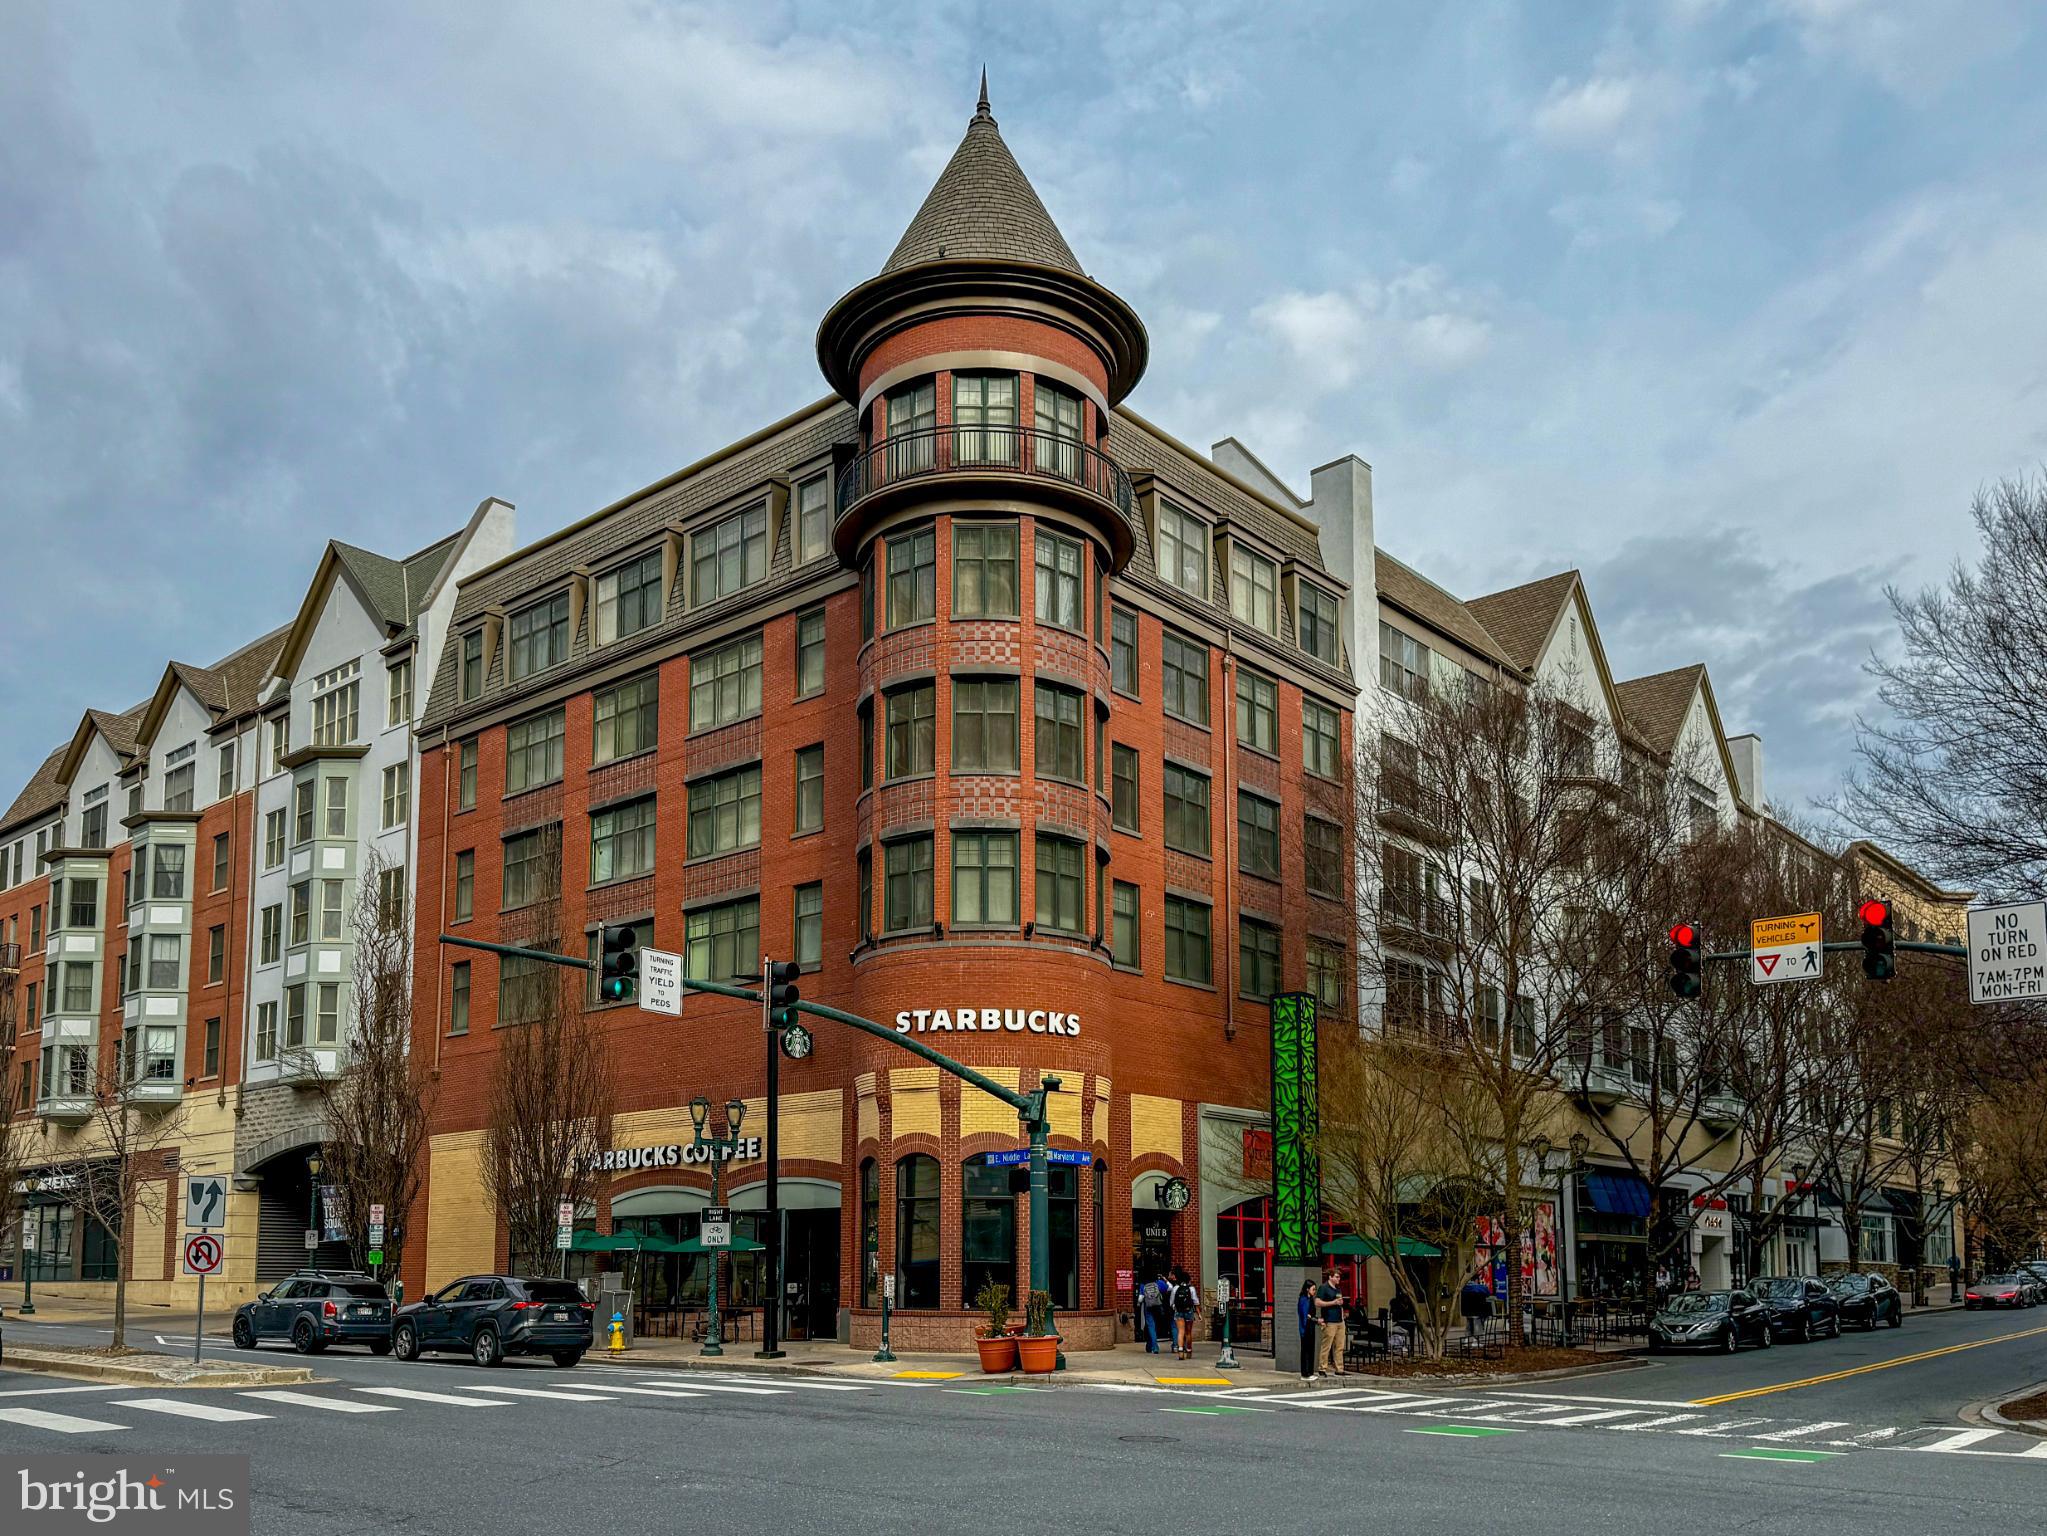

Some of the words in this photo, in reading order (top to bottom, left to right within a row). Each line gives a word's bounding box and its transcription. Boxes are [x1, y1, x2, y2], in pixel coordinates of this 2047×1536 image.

[1756, 921, 1796, 933] TURNING
[1995, 913, 2018, 930] NO
[1756, 933, 1796, 944] VEHICLES
[1988, 929, 2028, 946] TURN
[1981, 947, 2001, 962] ON
[2008, 944, 2037, 959] RED
[649, 955, 674, 966] TURNING
[1785, 957, 1797, 966] TO
[650, 966, 673, 977] TRAFFIC
[649, 976, 675, 988] YIELD
[1982, 980, 2041, 998] MON-FRI
[650, 998, 671, 1008] PEDS
[896, 1009, 1081, 1036] STARBUCKS
[573, 1145, 679, 1172] ARBUCKS
[1053, 1151, 1075, 1162] Maryland
[1082, 1153, 1090, 1162] Ave
[1145, 1227, 1161, 1237] UNIT
[1162, 1228, 1168, 1237] B
[707, 1235, 725, 1244] ONLY
